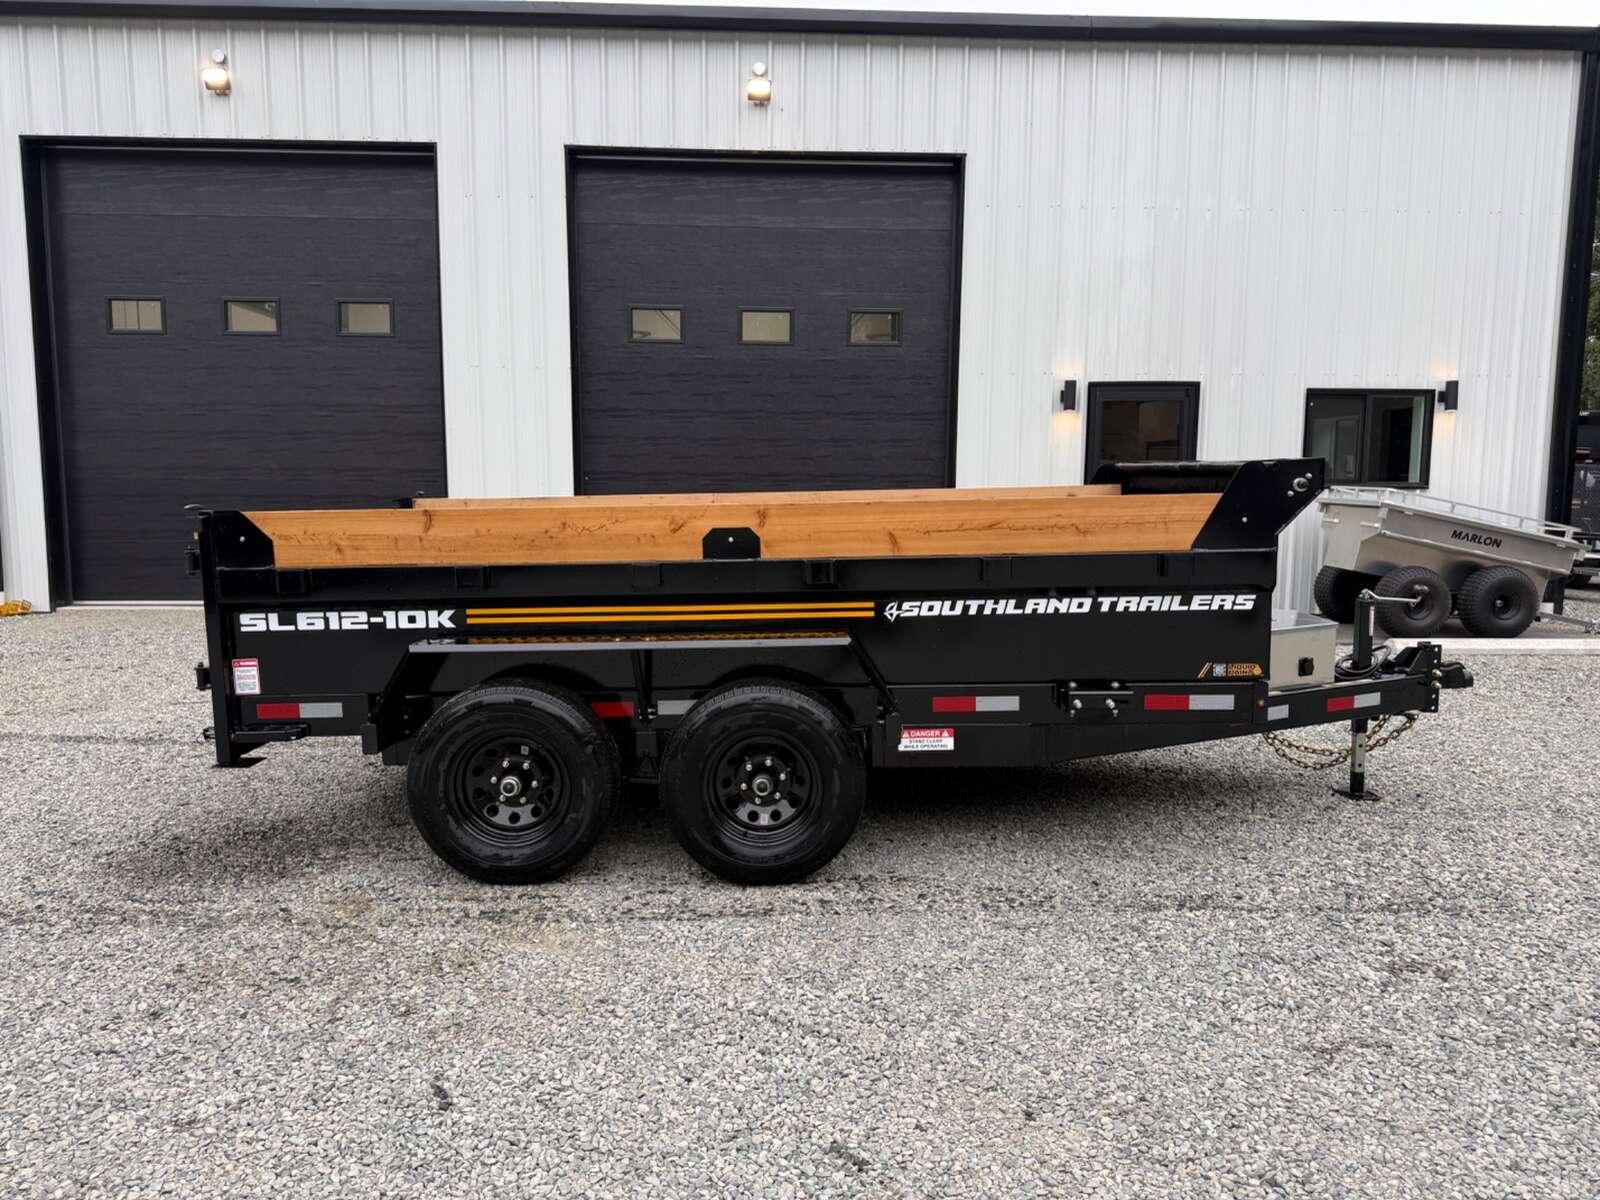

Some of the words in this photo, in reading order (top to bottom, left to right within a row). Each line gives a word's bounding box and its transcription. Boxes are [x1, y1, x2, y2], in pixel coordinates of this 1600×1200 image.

[1450, 529, 1503, 548] MARLON
[897, 596, 1093, 618] SOUTHLAND
[1098, 594, 1257, 612] TRAILERS
[239, 609, 456, 632] SL612-10K
[910, 729, 941, 738] DANGER
